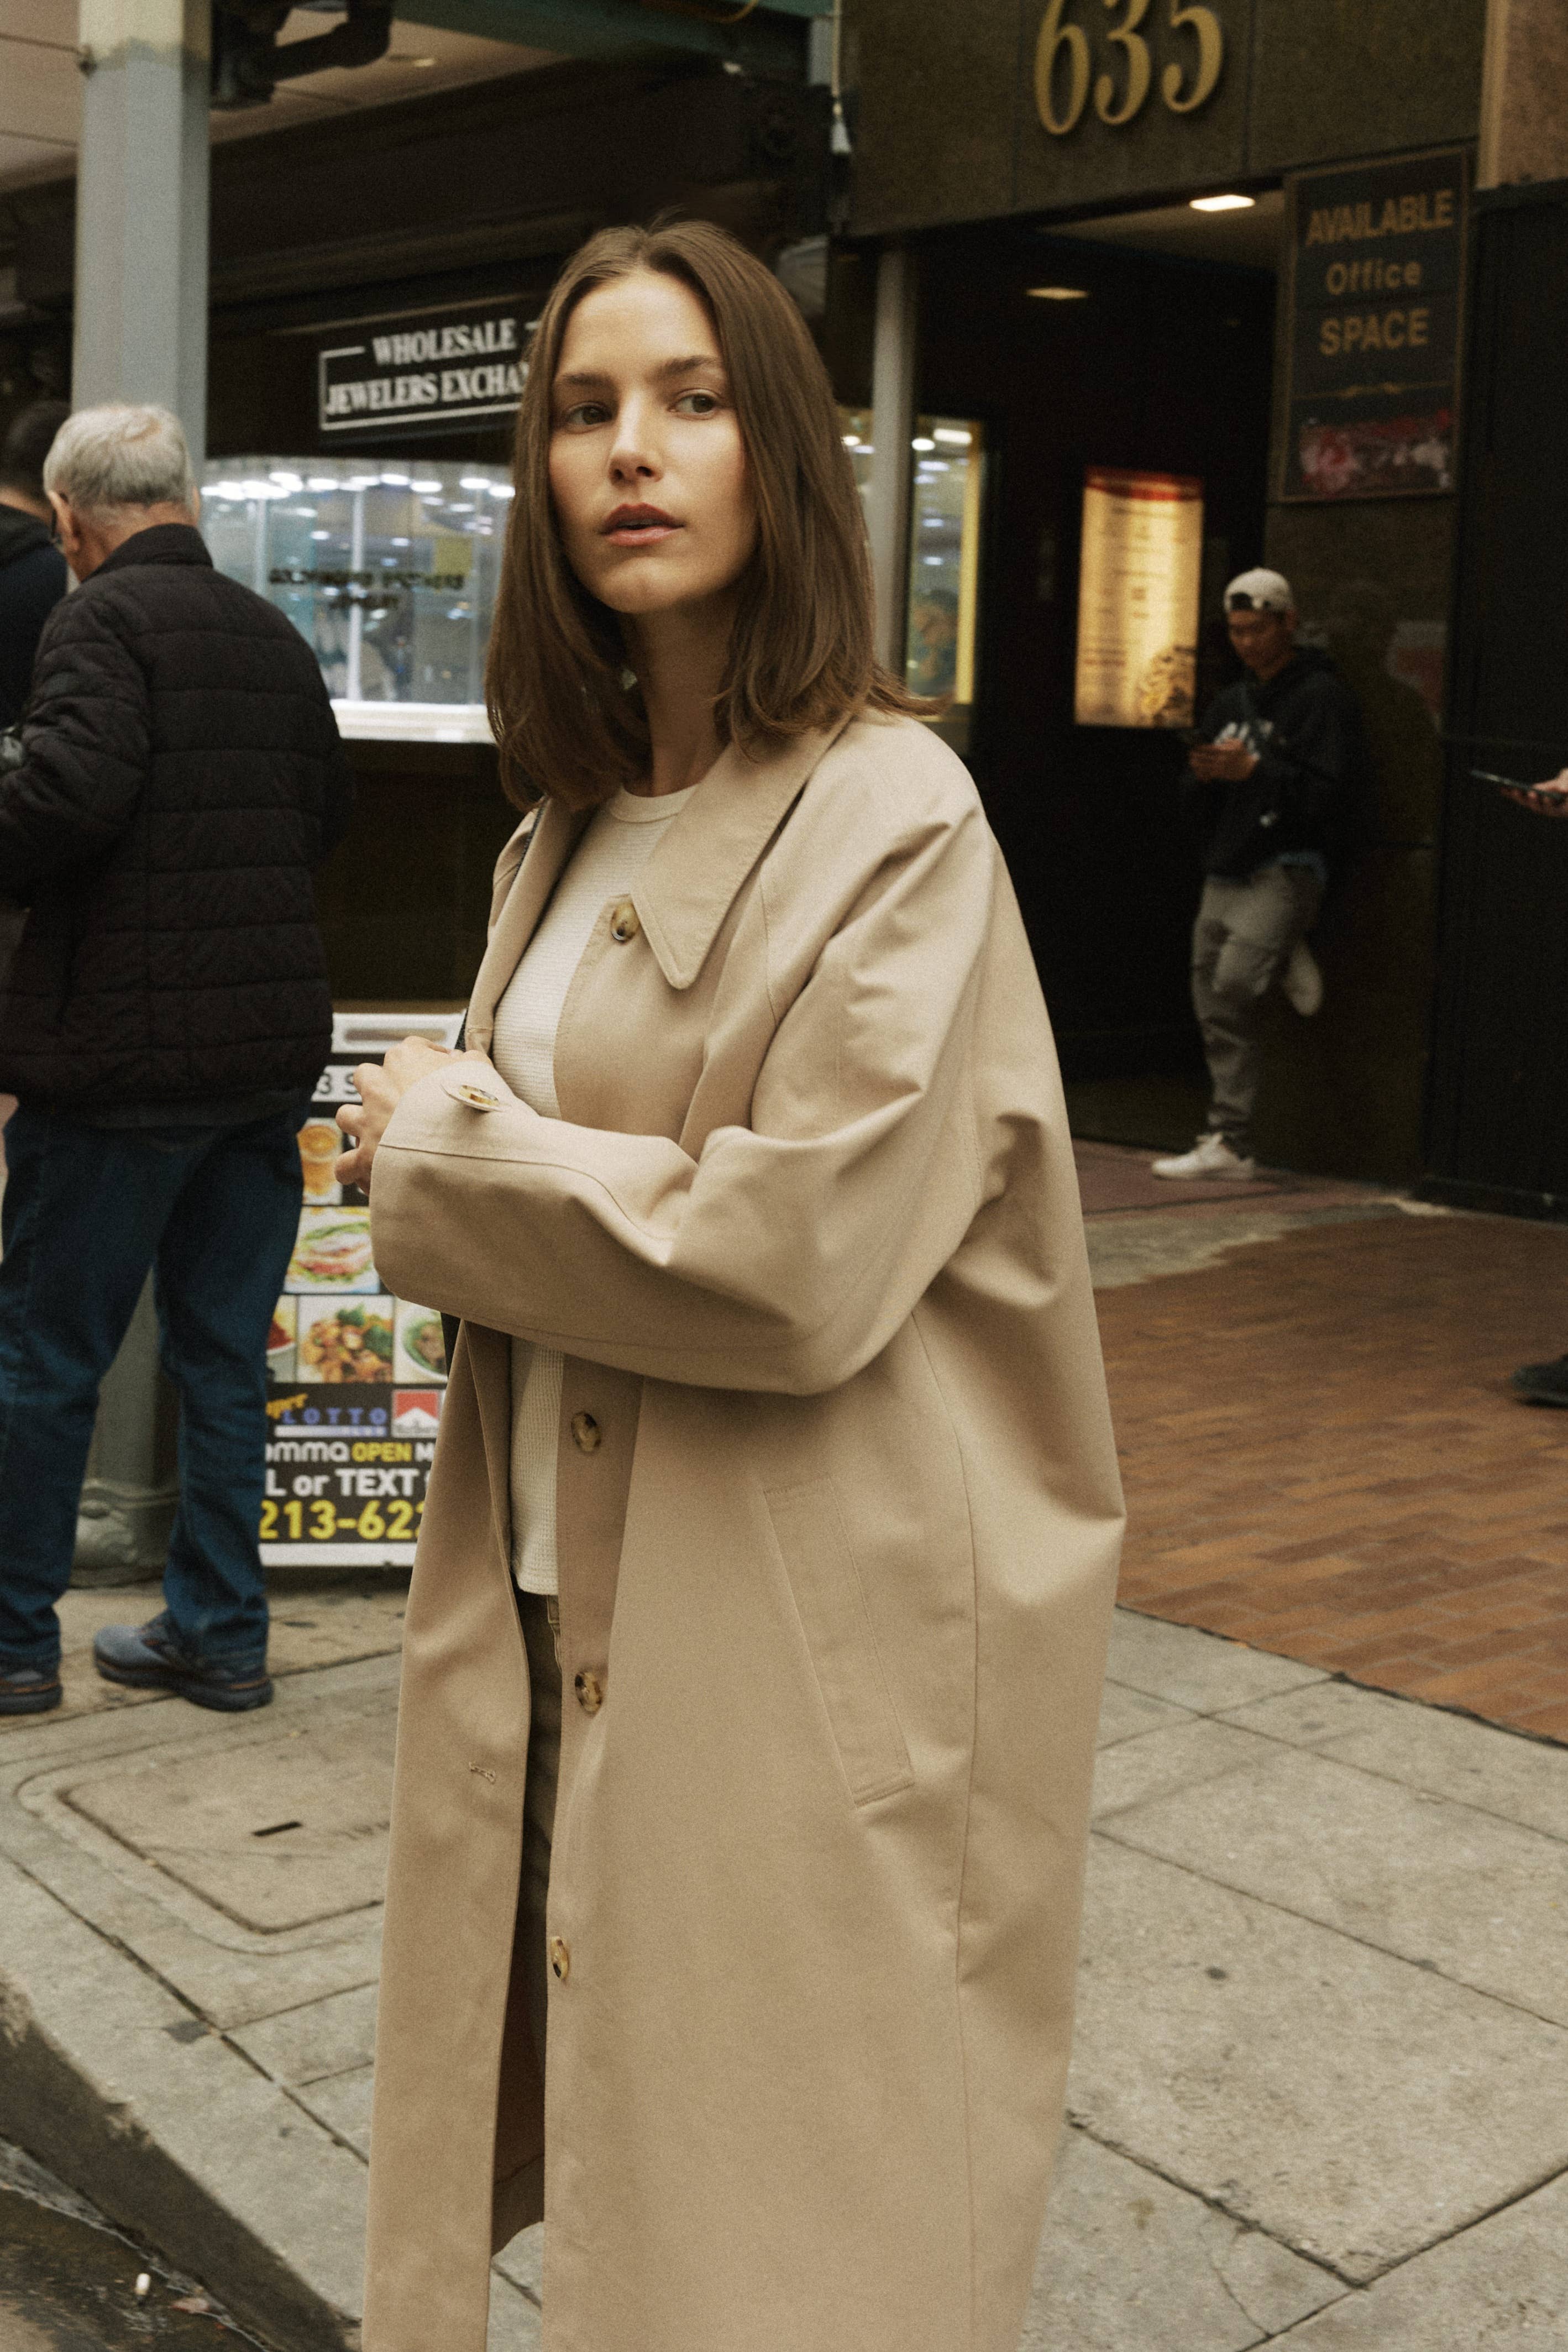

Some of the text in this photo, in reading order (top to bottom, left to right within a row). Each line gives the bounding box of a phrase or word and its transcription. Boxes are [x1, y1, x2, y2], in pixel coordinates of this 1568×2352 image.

[1035, 0, 1223, 134] 635
[1305, 190, 1455, 246] AVAILABLE
[1326, 258, 1422, 295] Office
[373, 318, 517, 366] WHOLESALE
[1319, 307, 1429, 356] SPACE
[326, 373, 439, 415] JEWELERS
[351, 1442, 413, 1463] OPEN
[292, 1475, 331, 1497] or
[334, 1468, 419, 1497] TEXT
